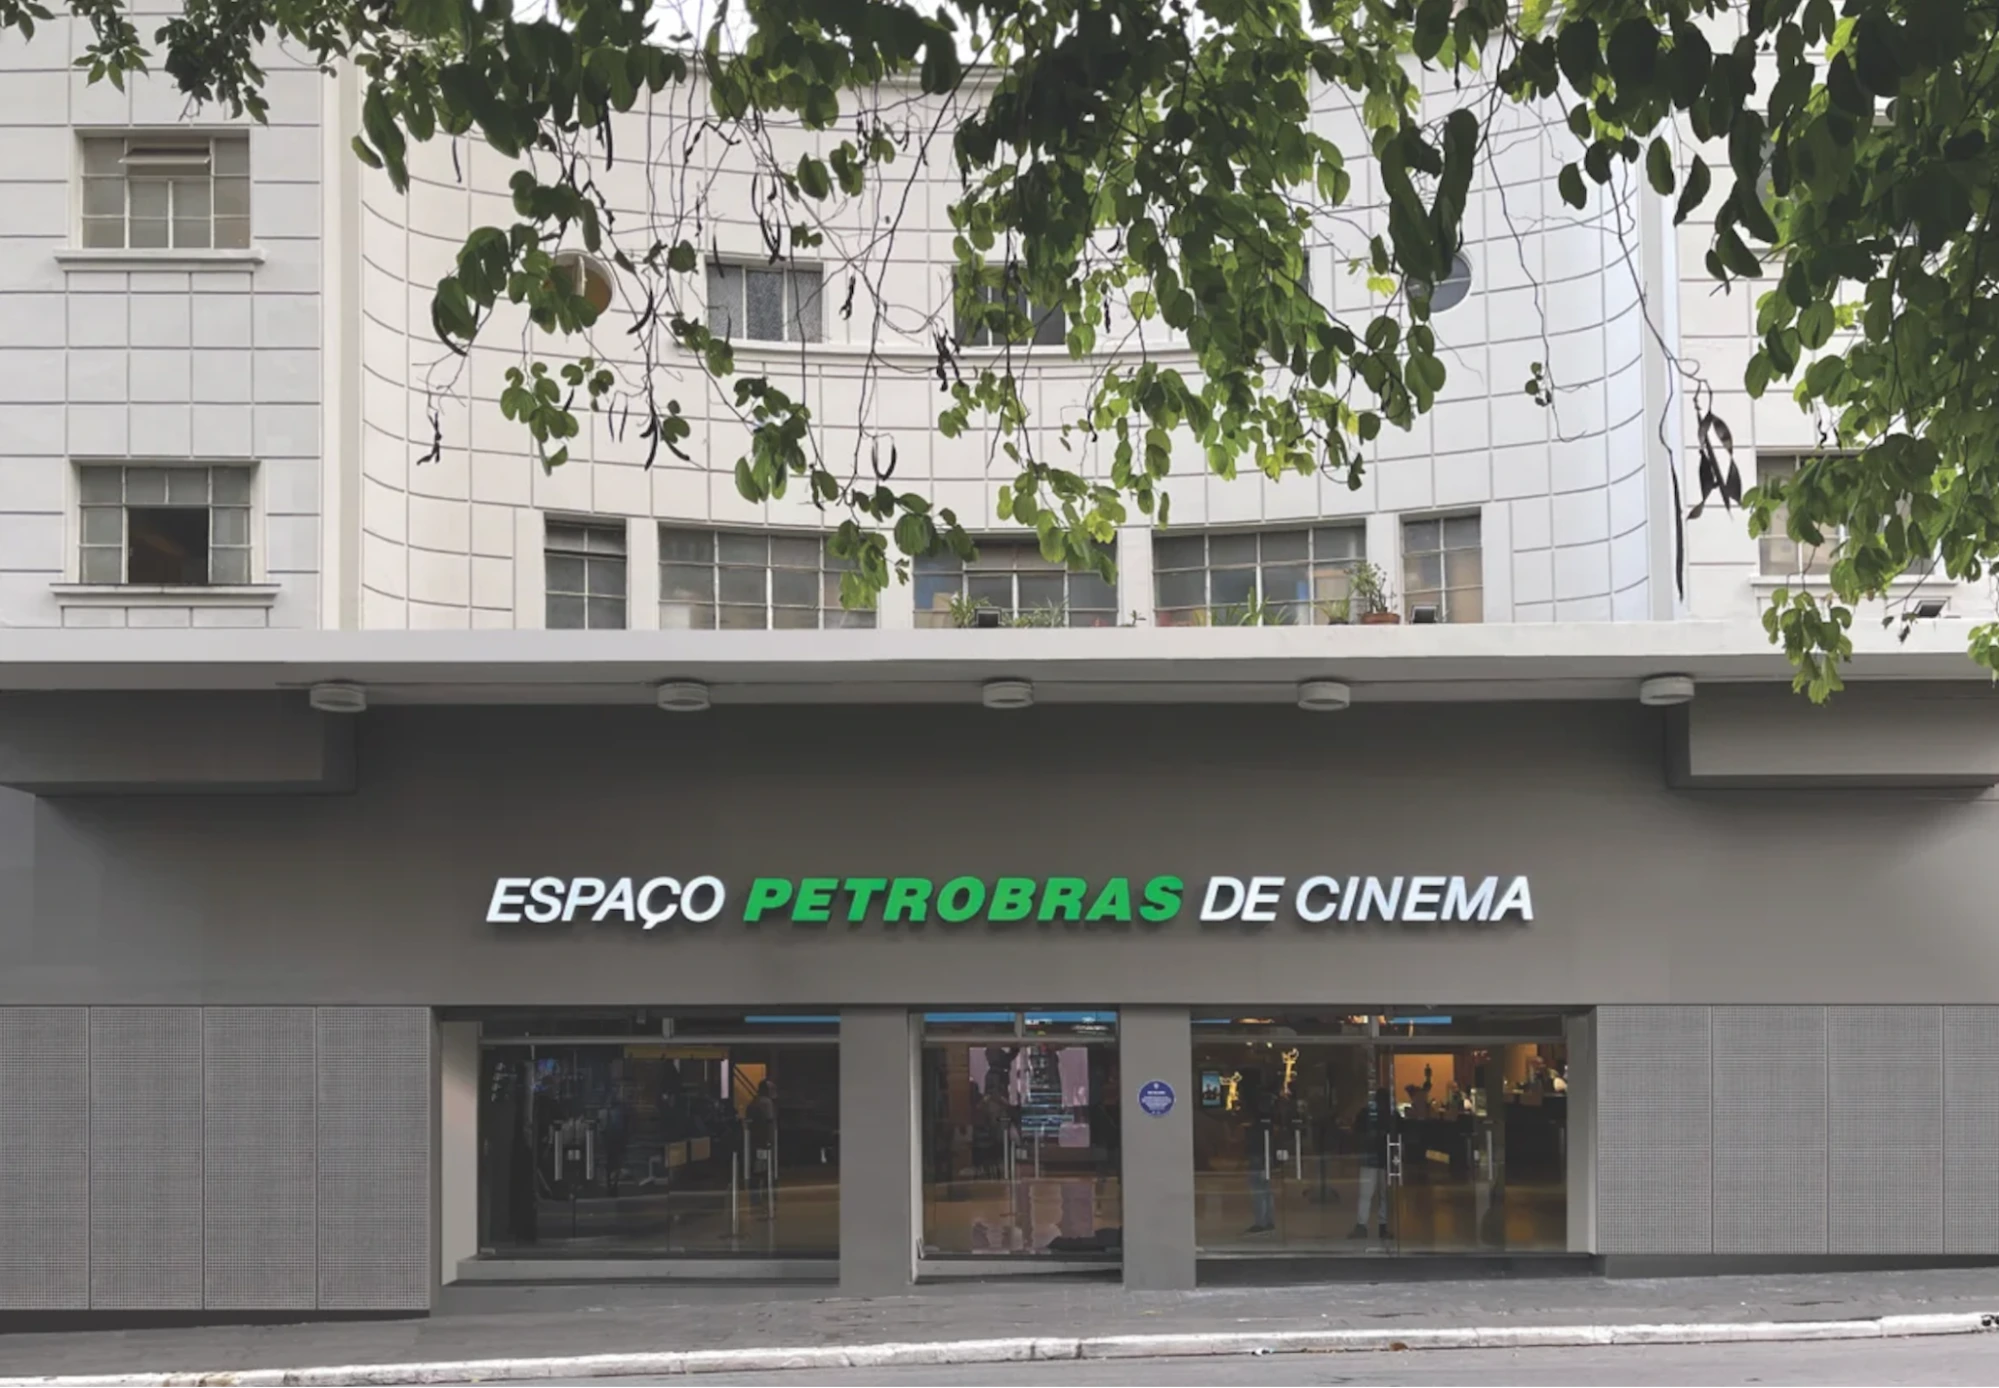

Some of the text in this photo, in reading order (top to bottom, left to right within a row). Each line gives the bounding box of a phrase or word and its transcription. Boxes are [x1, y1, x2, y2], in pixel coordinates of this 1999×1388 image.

[486, 875, 1533, 929] ESPAÇO PETROBRAS DE CINEMA
